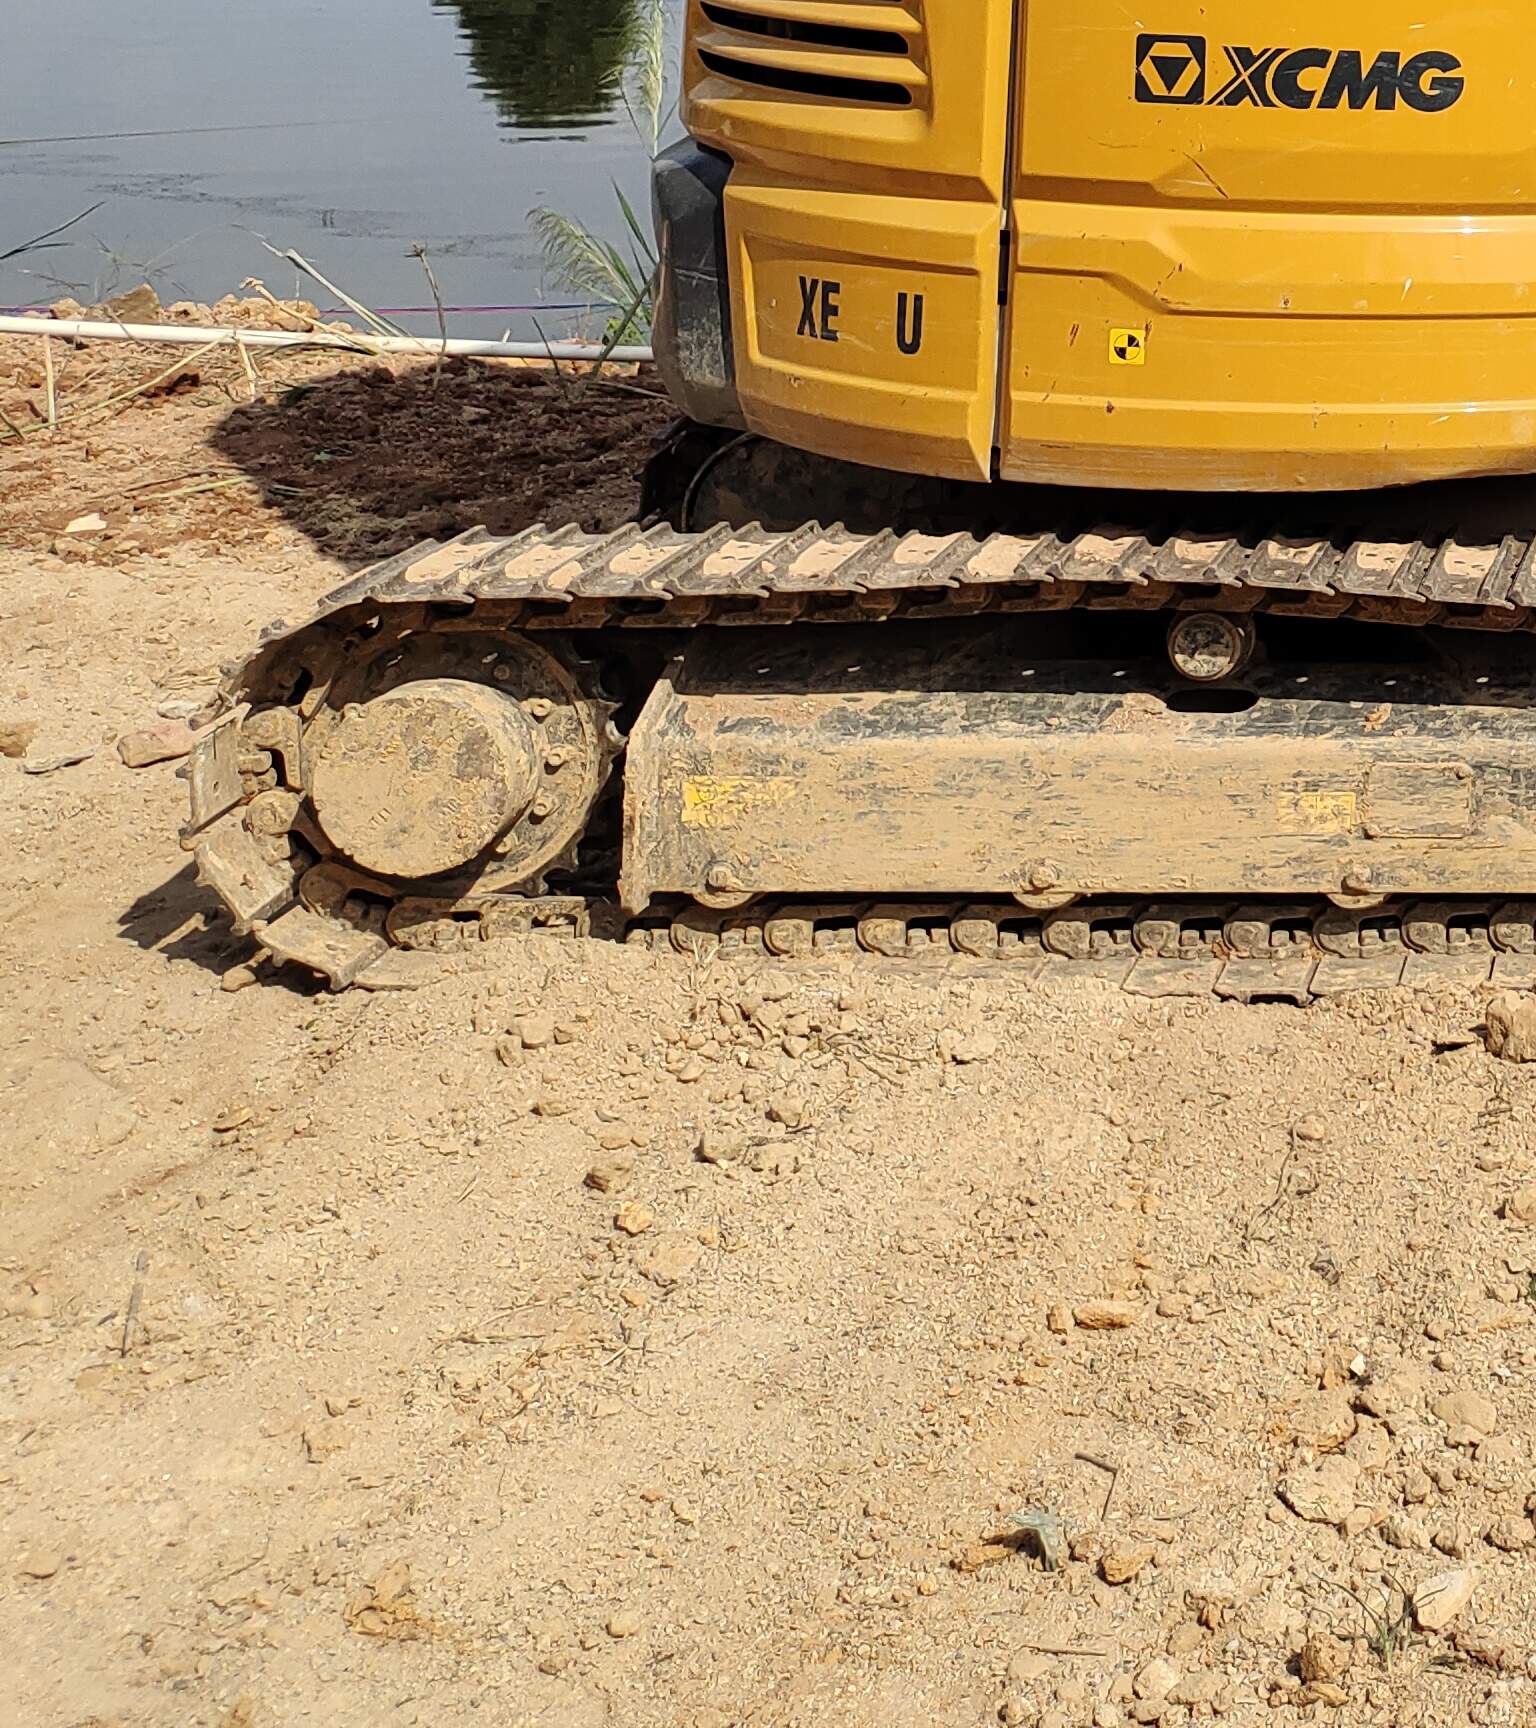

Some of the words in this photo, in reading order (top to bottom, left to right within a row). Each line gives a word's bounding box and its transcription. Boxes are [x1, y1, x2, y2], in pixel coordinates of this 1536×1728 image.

[1204, 45, 1465, 113] XCMG
[796, 275, 841, 342] XE
[896, 292, 924, 355] U
